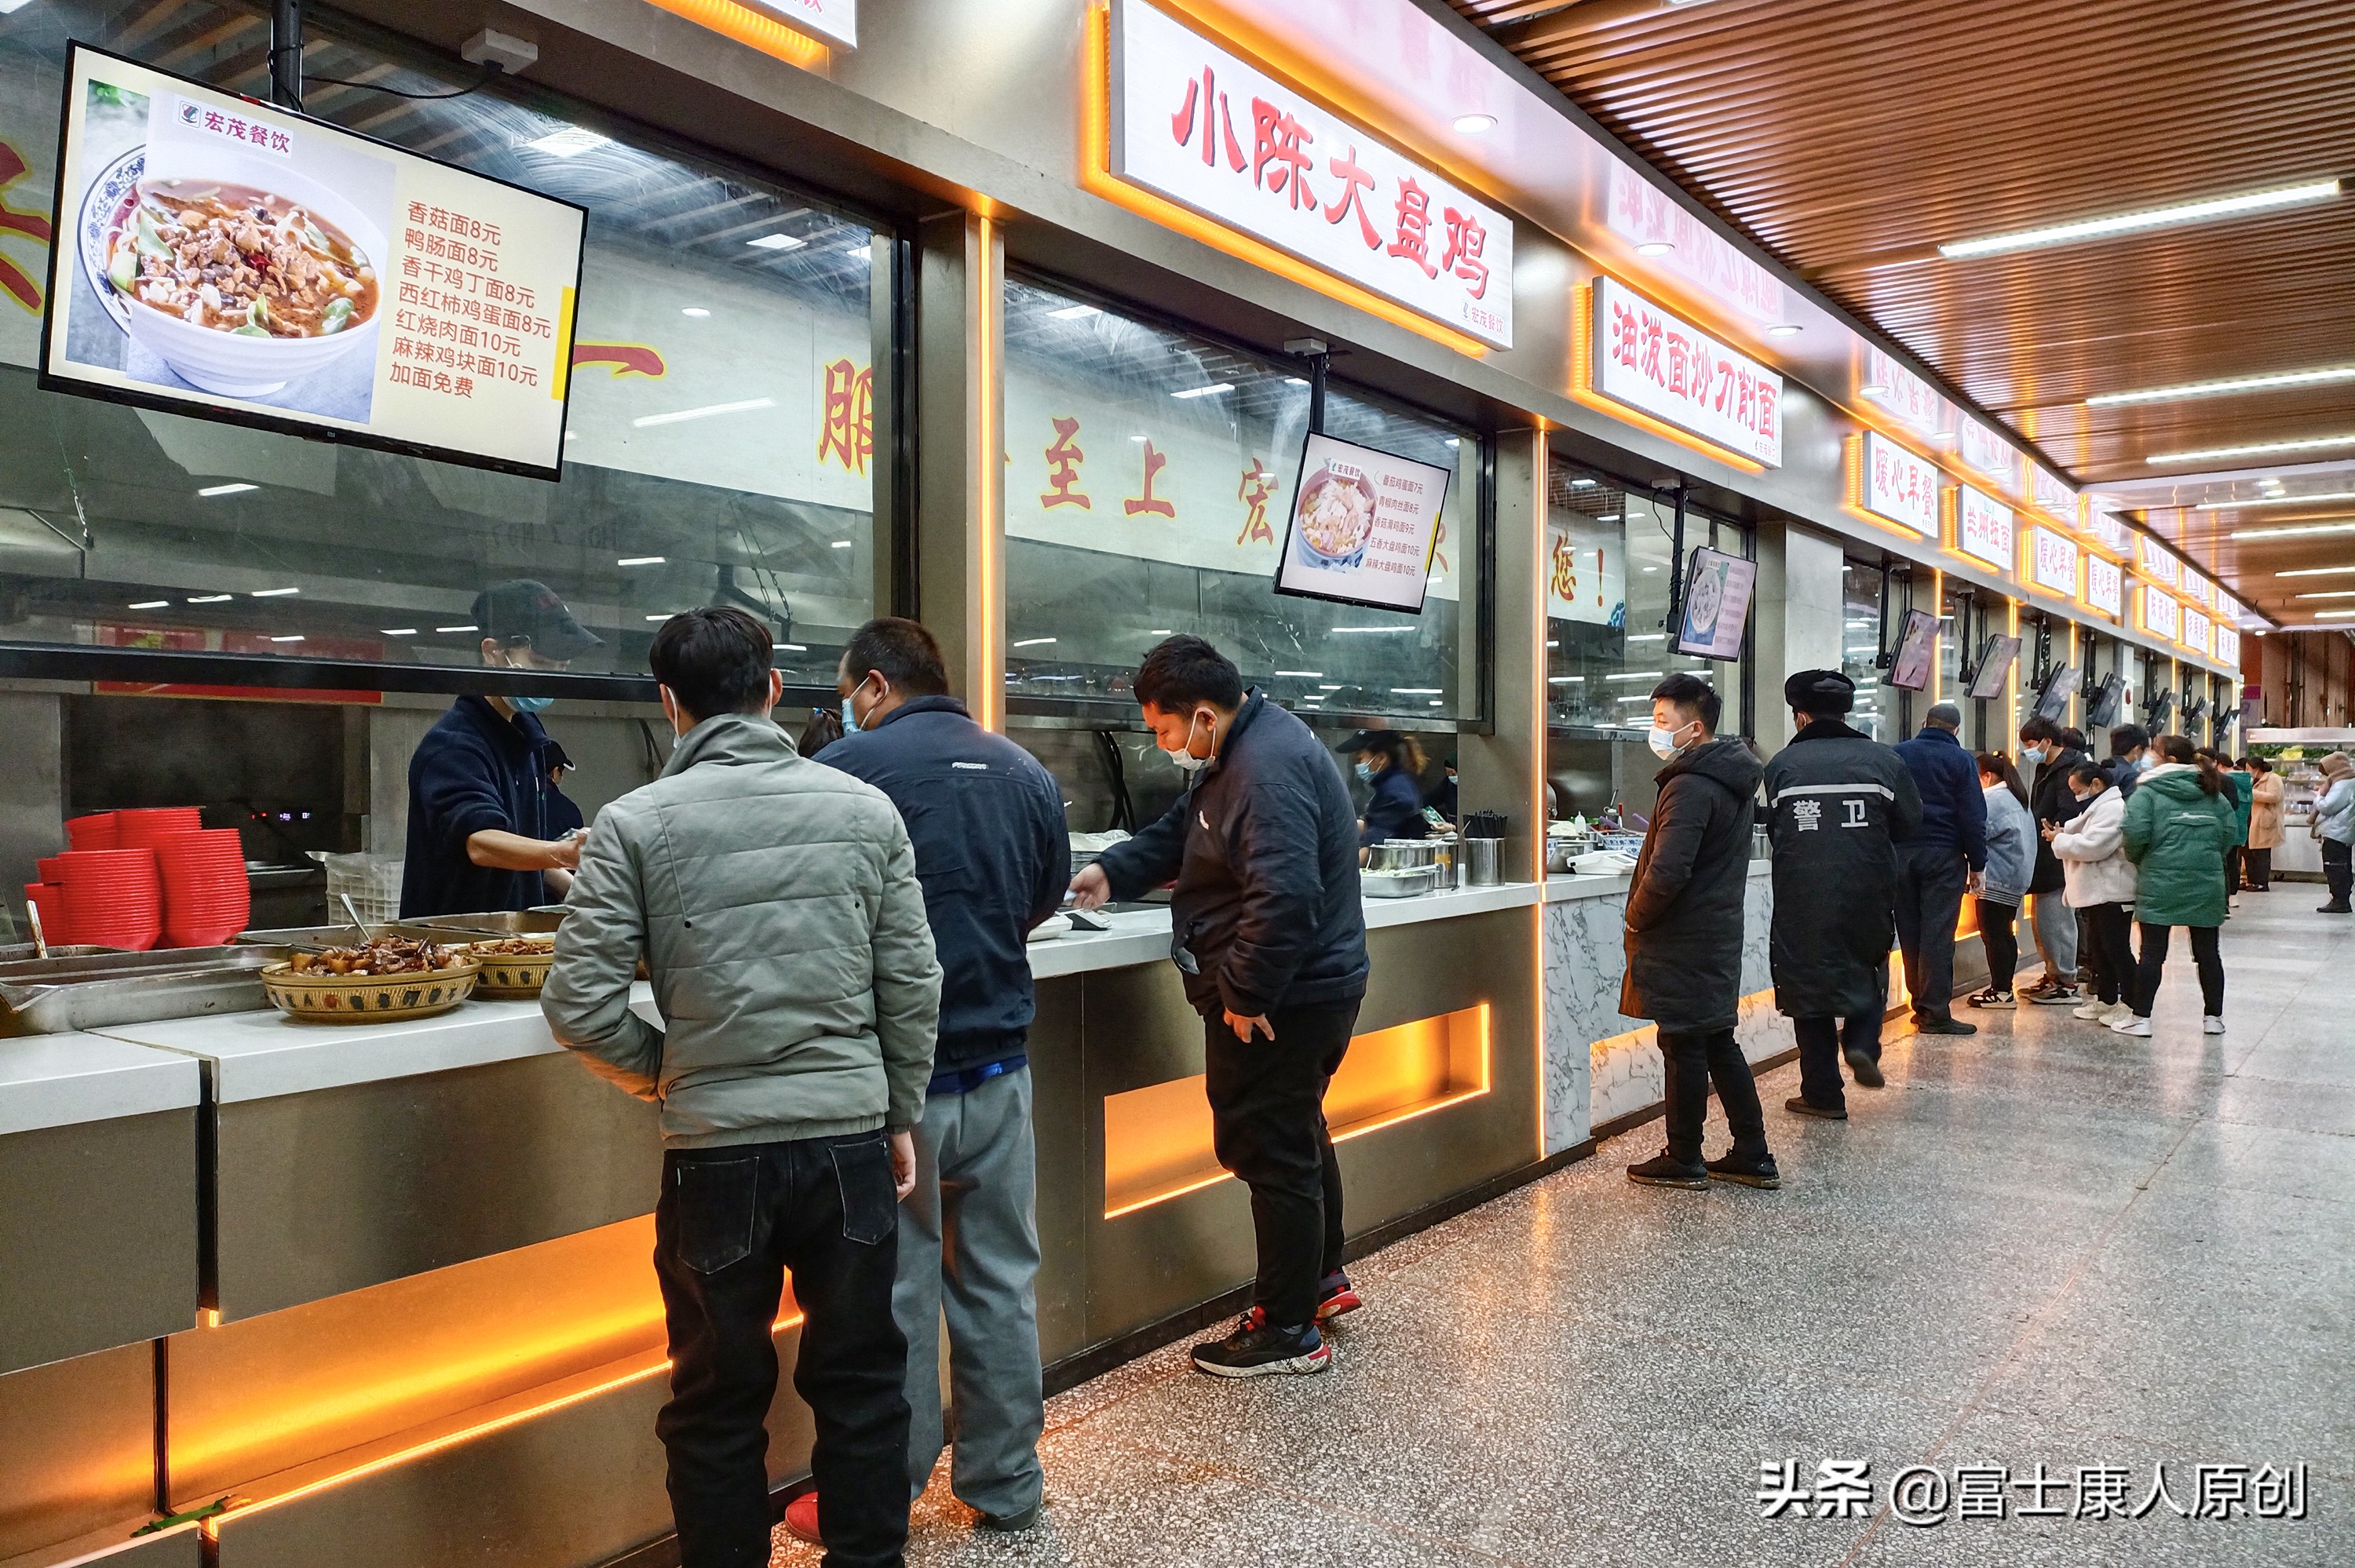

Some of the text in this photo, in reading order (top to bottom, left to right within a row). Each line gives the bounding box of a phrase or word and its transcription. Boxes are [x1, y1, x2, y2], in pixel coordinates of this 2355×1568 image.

[204, 111, 290, 153] 宏茂餐饮
[1171, 64, 1489, 300] 小陈大盘鸡
[407, 200, 502, 246] 香菇面8元
[404, 228, 498, 272] 鸭肠面8元
[402, 255, 535, 308] 香干鸡丁面8元
[396, 308, 521, 357] 红烧肉面10元
[399, 281, 552, 339] 西红柿鸡蛋面8元
[389, 362, 473, 399] 加面免费
[392, 336, 539, 387] 麻辣鸡块面10元
[1338, 463, 1361, 478] 宏茂餐饮
[1875, 446, 1934, 519] 暖心早餐
[1967, 505, 2010, 553] 兰州拉面
[1793, 799, 1869, 832] 警卫
